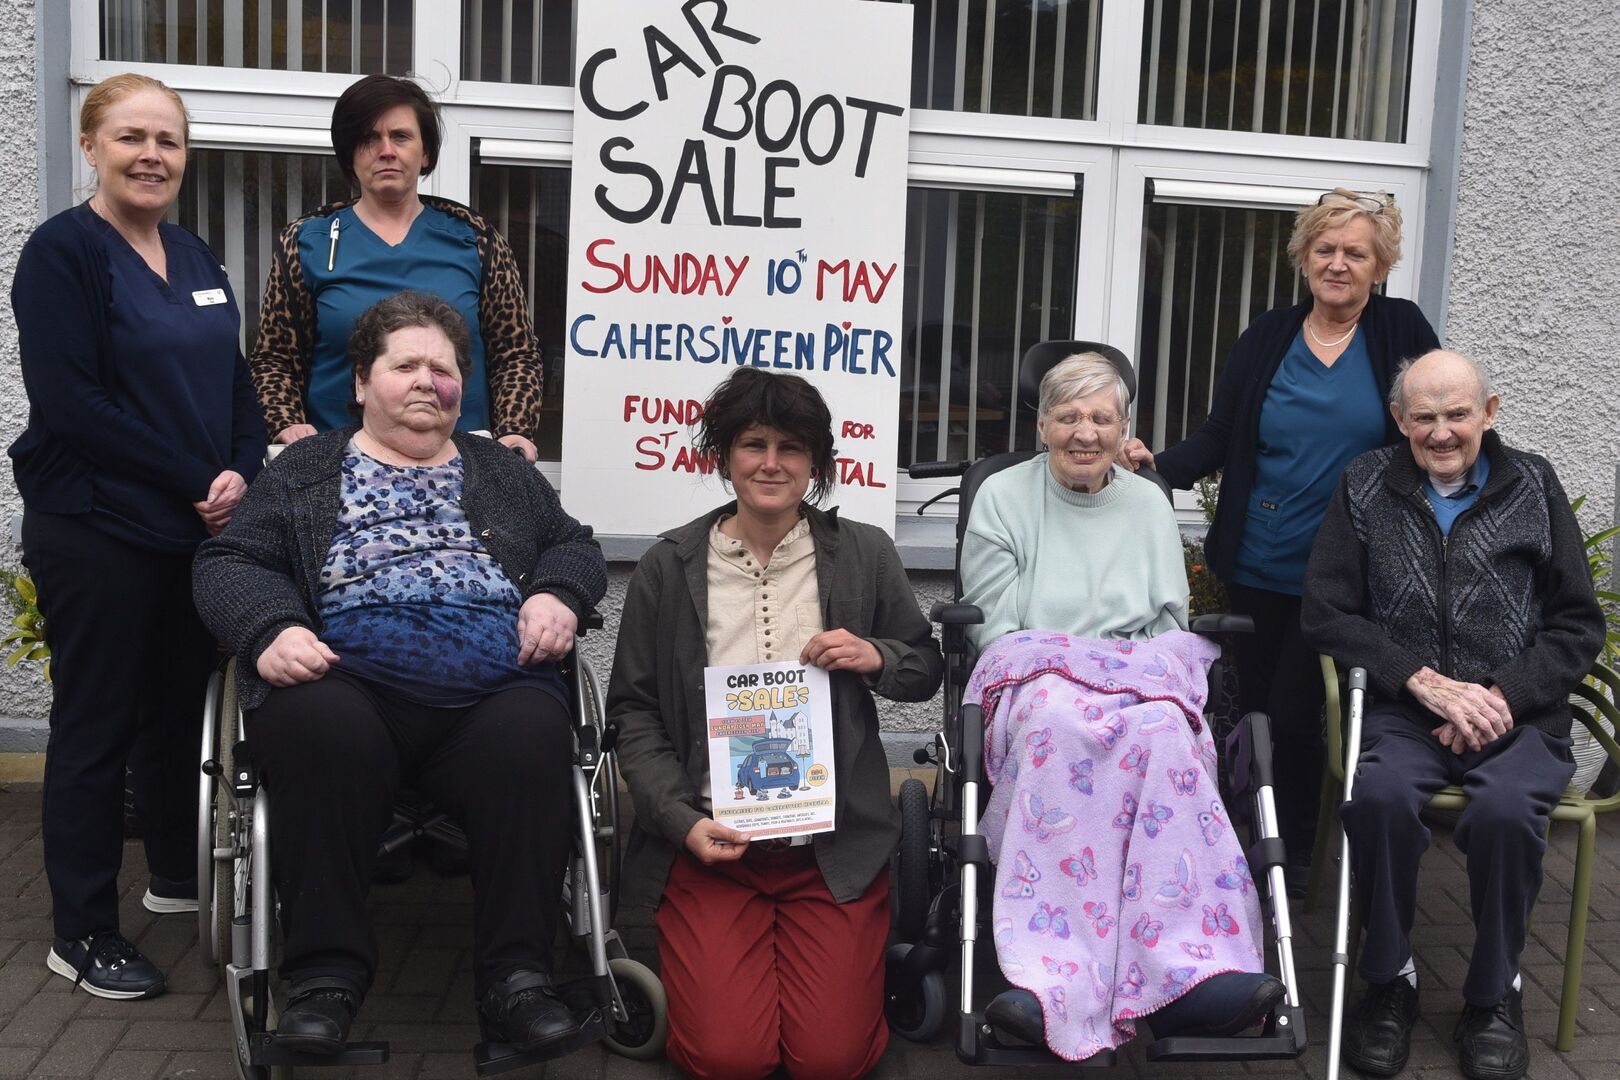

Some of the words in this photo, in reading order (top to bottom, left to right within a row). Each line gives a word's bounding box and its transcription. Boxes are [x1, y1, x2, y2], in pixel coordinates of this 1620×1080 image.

[579, 0, 761, 121] CAR
[702, 65, 905, 178] BOOT
[595, 136, 801, 228] SALE
[581, 239, 749, 296] SUNDAY
[816, 259, 898, 304] MAY
[841, 420, 876, 440] FOR
[727, 674, 759, 688] CAR
[763, 669, 806, 685] BOOT
[737, 685, 798, 711] SALE
